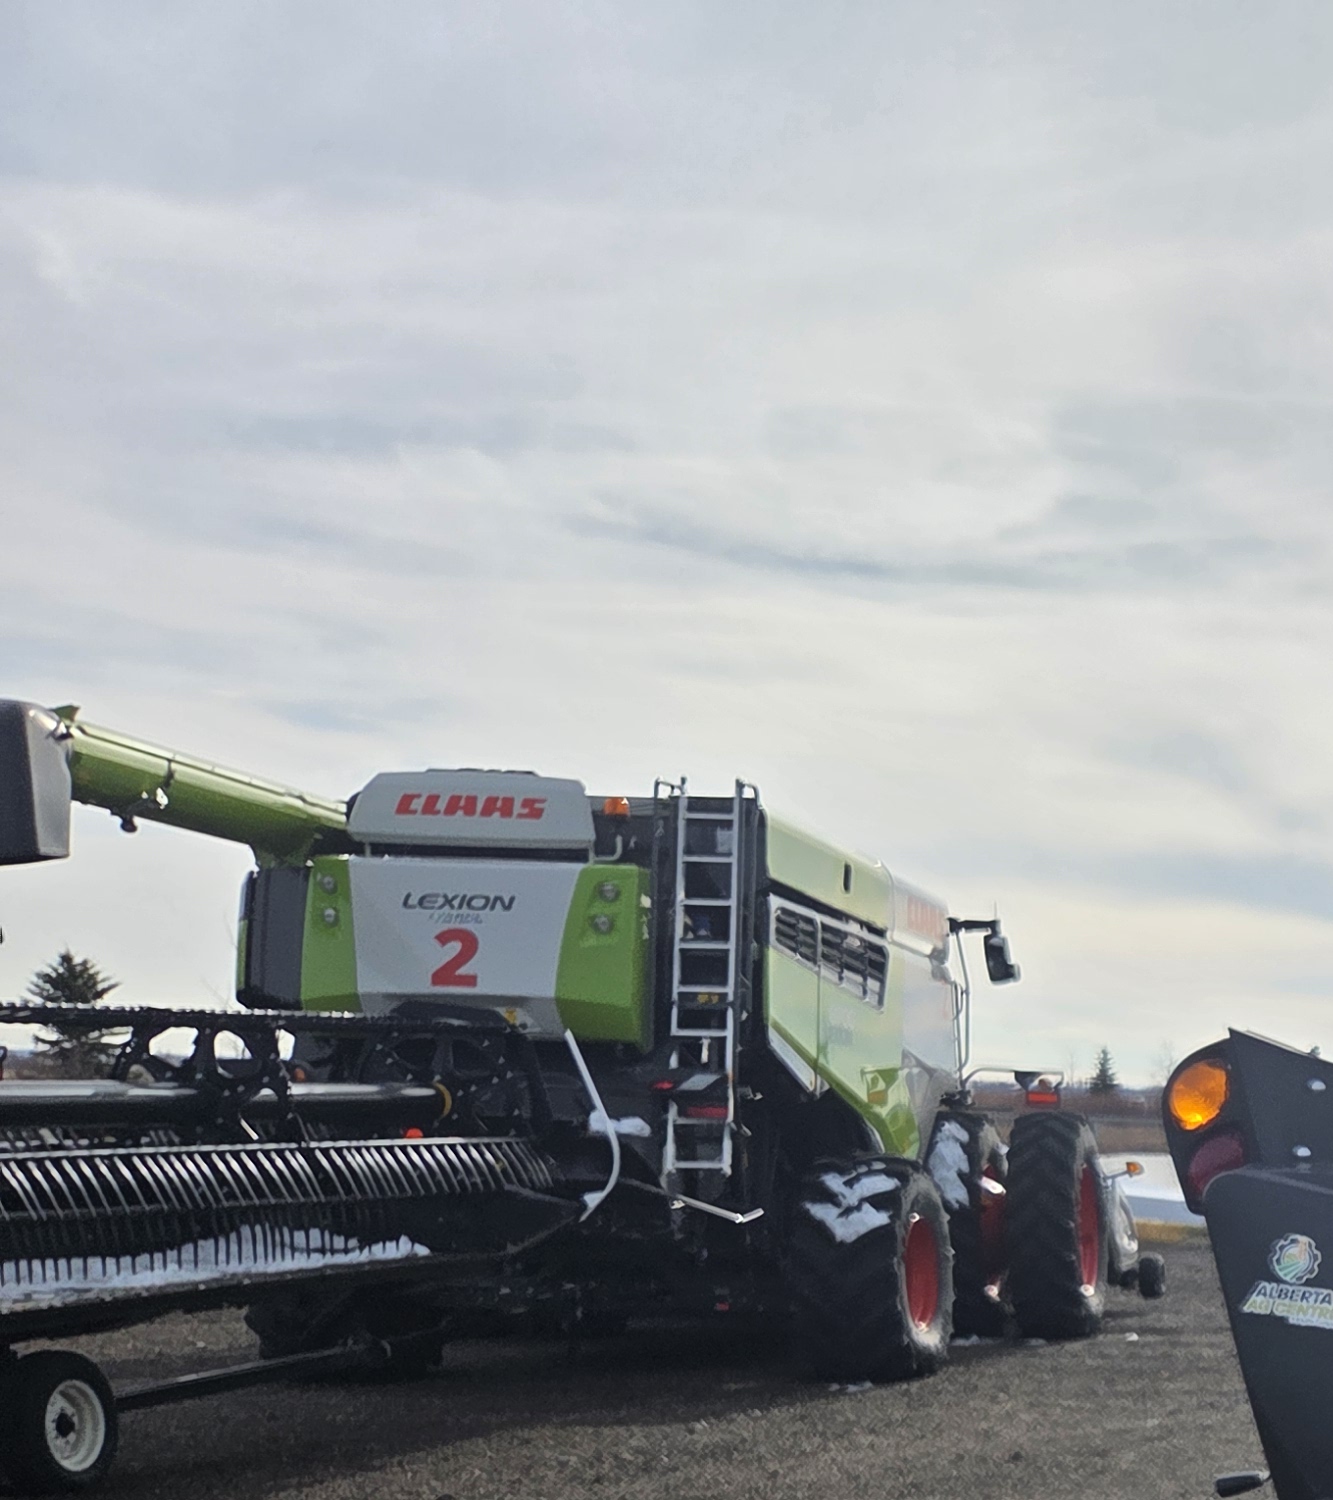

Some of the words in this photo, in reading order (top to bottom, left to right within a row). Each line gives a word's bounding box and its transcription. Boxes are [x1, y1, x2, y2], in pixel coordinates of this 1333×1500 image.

[395, 793, 548, 820] CLAAS
[402, 892, 516, 912] LEXION
[431, 927, 479, 988] 2
[1247, 1299, 1270, 1312] AG
[1255, 1284, 1332, 1306] ALBERTA
